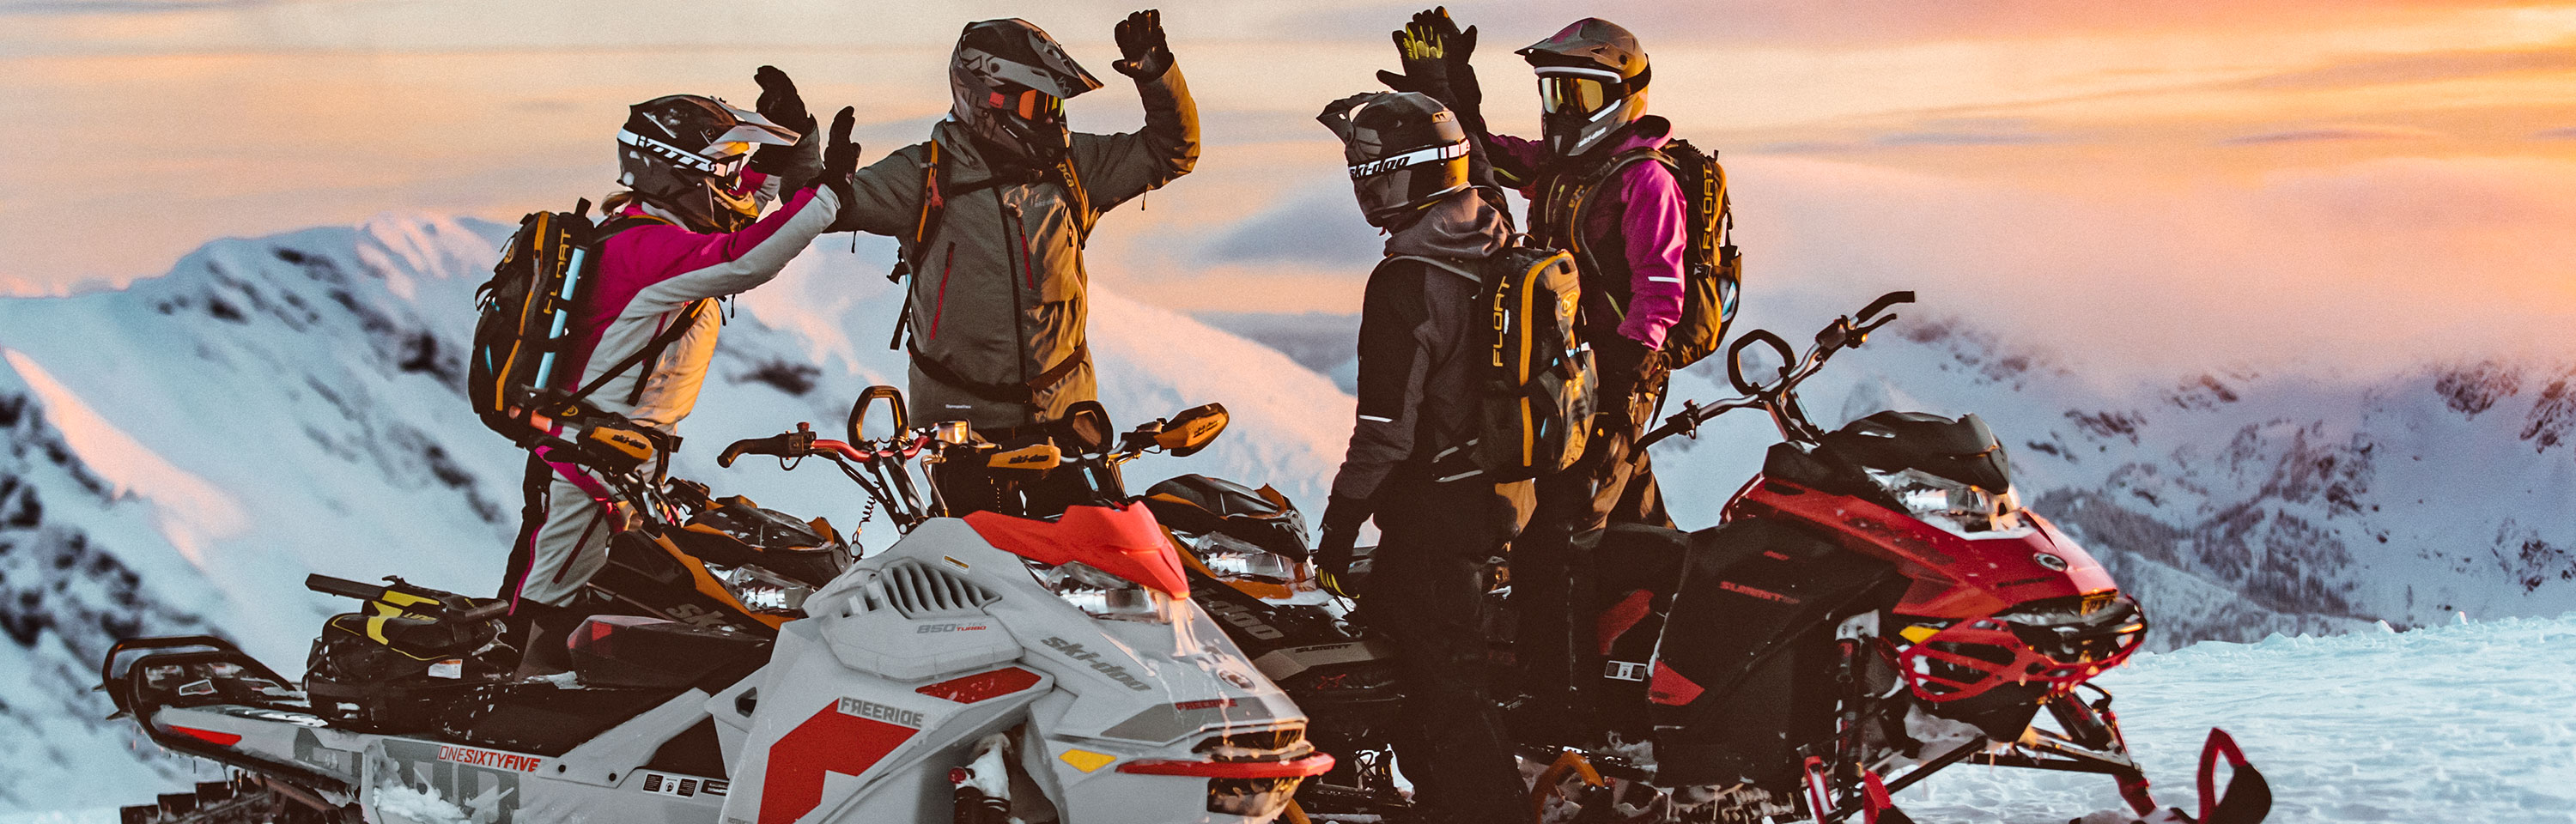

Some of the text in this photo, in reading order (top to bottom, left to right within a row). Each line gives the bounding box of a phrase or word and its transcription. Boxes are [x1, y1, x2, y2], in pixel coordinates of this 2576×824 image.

[1702, 164, 1715, 250] FLOAT
[1492, 276, 1510, 367] FLOAT
[917, 624, 957, 633] 850
[1040, 637, 1152, 691] ski-doo
[840, 696, 925, 729] FREERIDE
[438, 746, 542, 772] ONESIXTYFIVE
